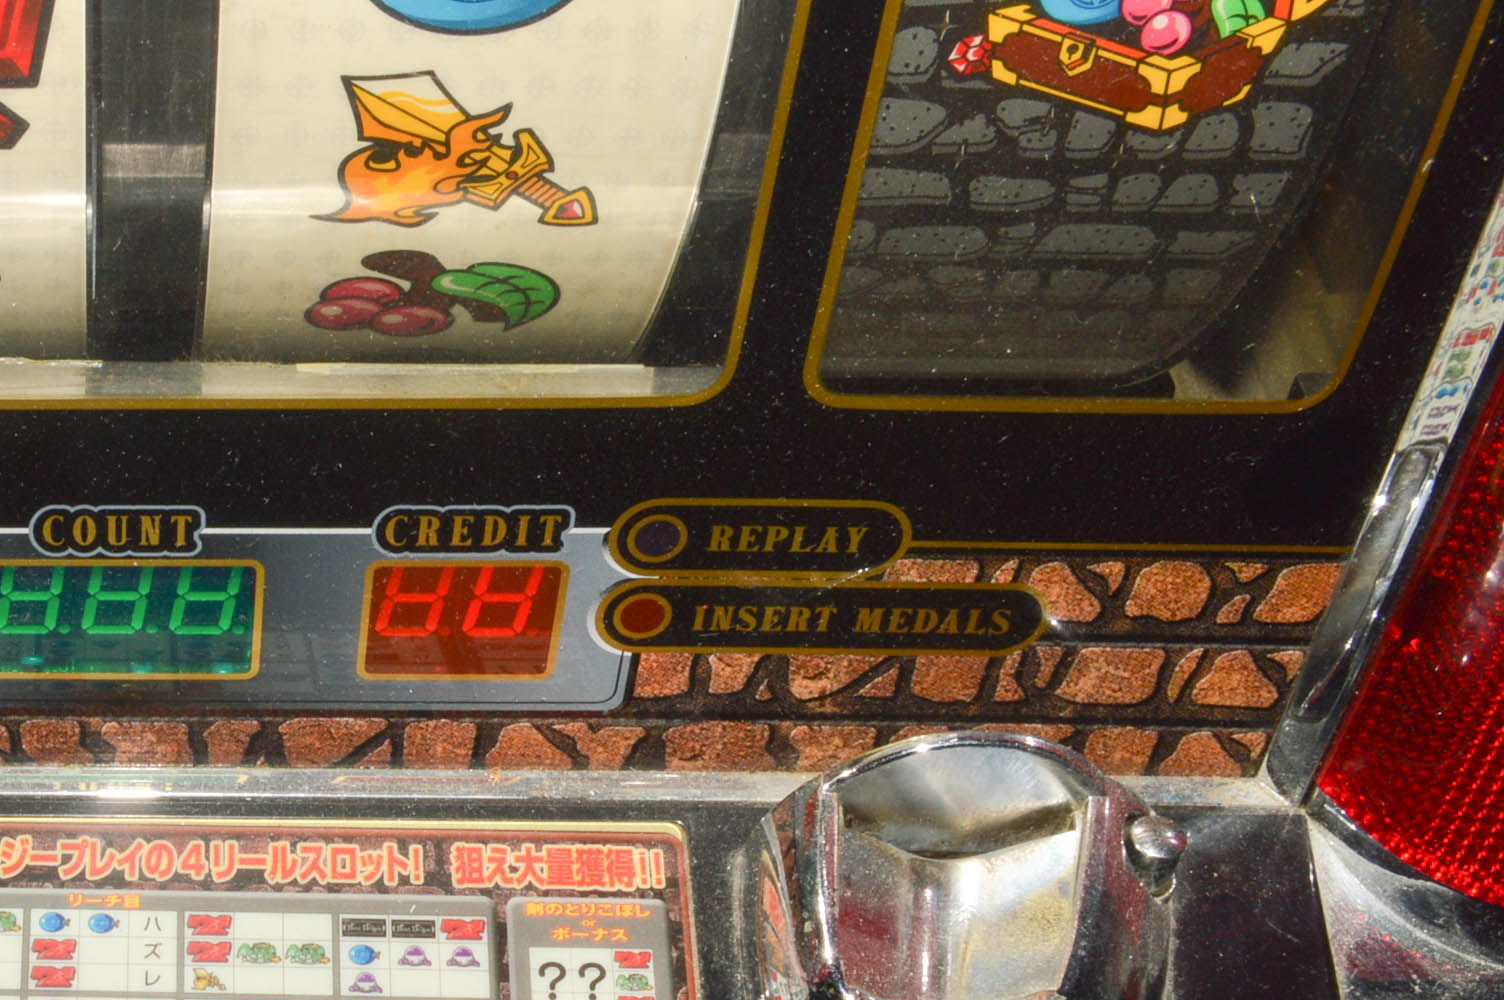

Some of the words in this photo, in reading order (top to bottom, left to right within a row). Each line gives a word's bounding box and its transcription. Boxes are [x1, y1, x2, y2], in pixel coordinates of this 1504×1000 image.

[41, 515, 194, 547] COUNT
[384, 514, 563, 548] CREDIT
[706, 524, 871, 555] REPLAY
[691, 604, 846, 635] INSERT
[851, 606, 1013, 636] MEDALS
[551, 927, 629, 942] ボーナス
